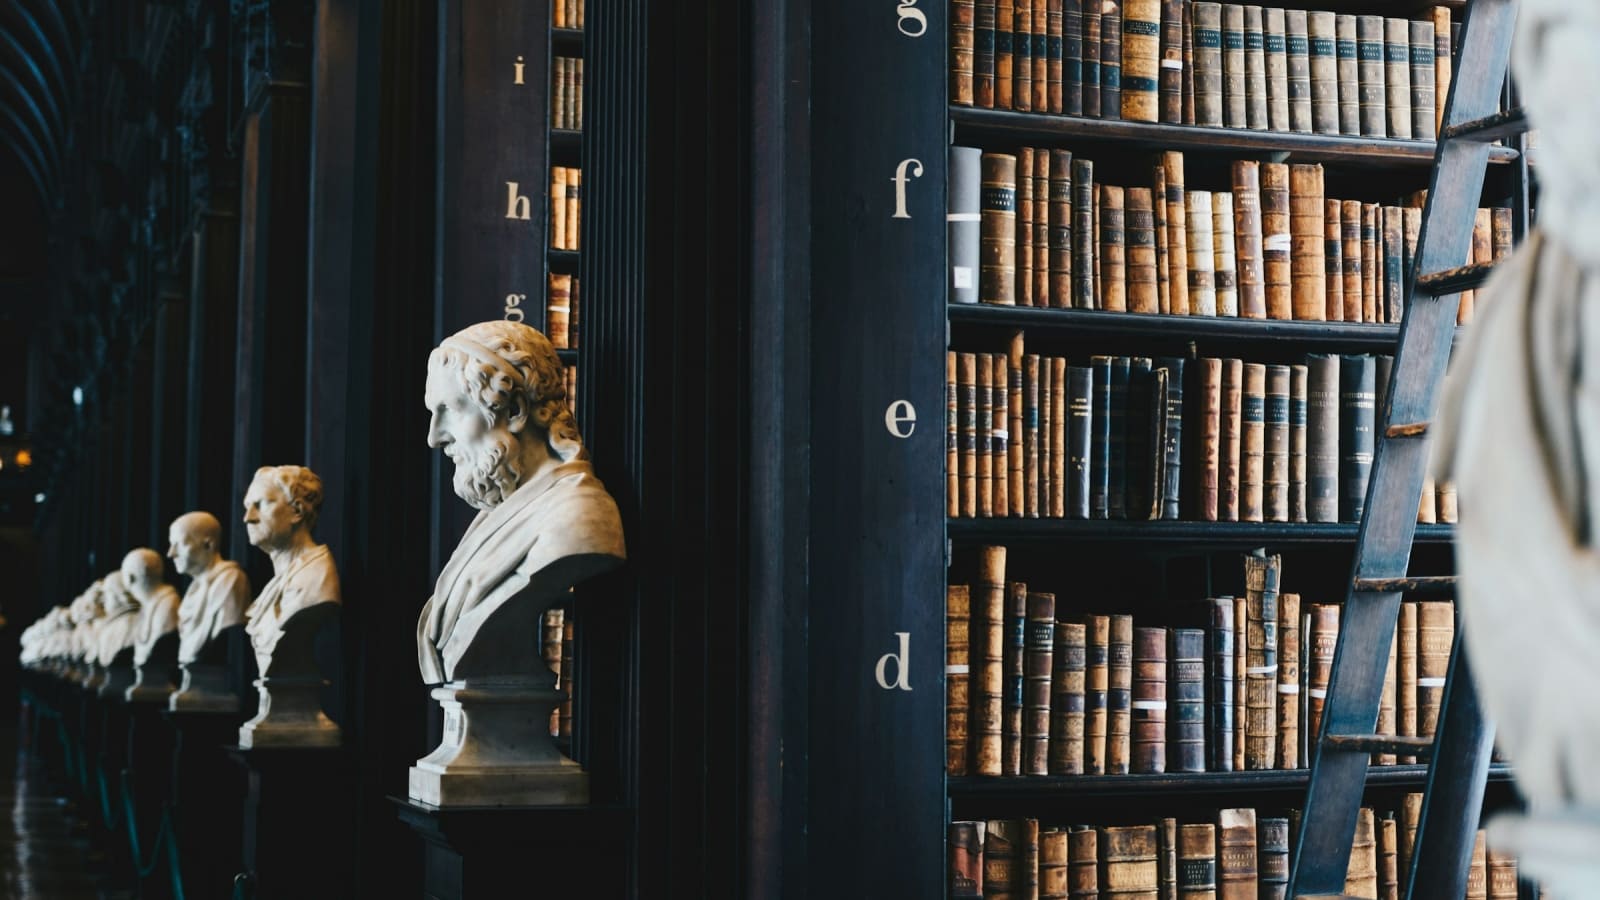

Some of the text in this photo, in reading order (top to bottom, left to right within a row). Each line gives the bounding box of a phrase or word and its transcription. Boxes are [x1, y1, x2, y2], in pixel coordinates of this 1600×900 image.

[897, 0, 927, 37] g
[514, 56, 525, 85] i
[505, 181, 531, 221] h
[890, 158, 923, 219] f
[504, 294, 526, 321] g
[885, 399, 917, 438] e
[875, 632, 913, 691] d
